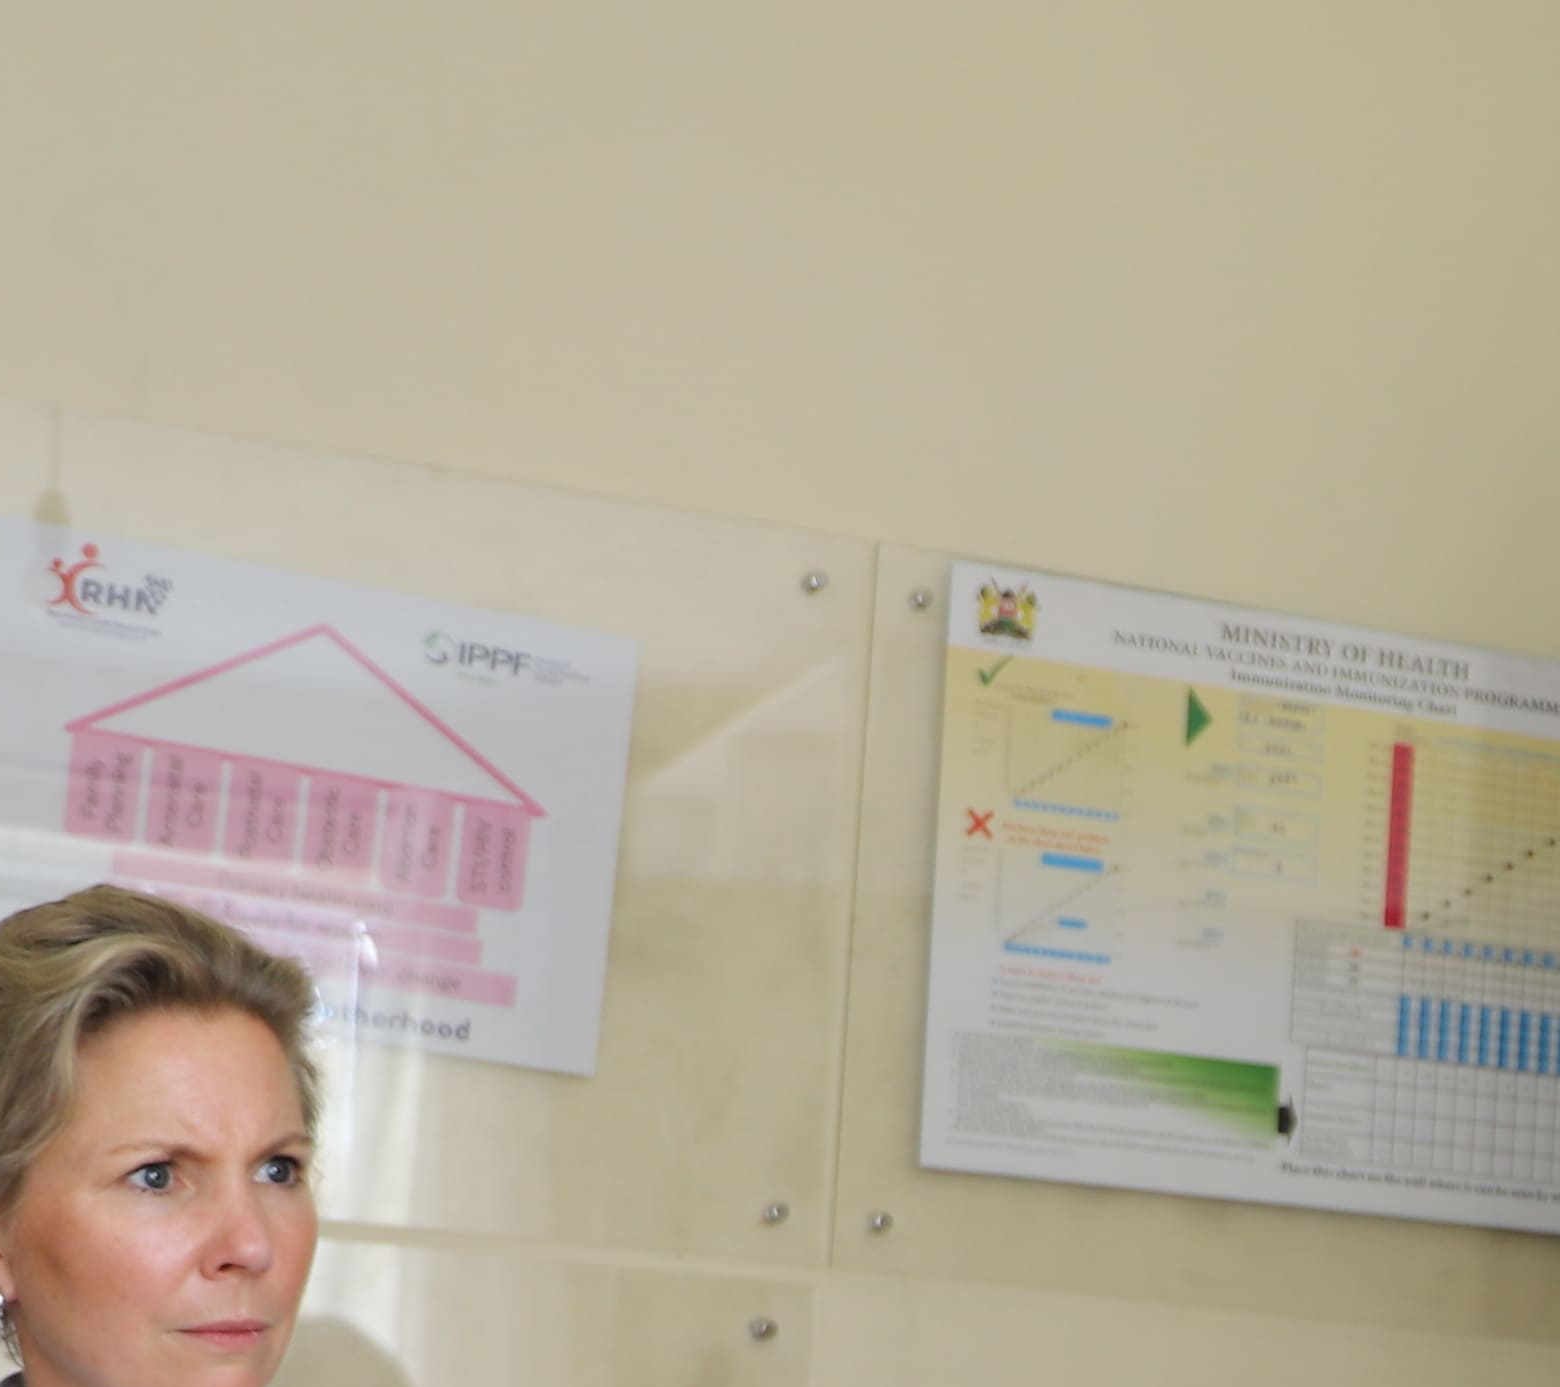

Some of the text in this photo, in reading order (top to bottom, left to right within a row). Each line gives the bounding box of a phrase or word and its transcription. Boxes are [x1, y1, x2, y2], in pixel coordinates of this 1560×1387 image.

[457, 640, 532, 676] IPPF
[1113, 630, 1200, 657] NATIONAL
[1206, 646, 1288, 670] VACCINES
[1292, 656, 1330, 677] AND
[1220, 624, 1471, 681] MINISTRY OF HEALTH
[186, 782, 209, 829] Care
[266, 795, 288, 842] Care
[343, 811, 362, 857] Care
[420, 825, 441, 872] Care
